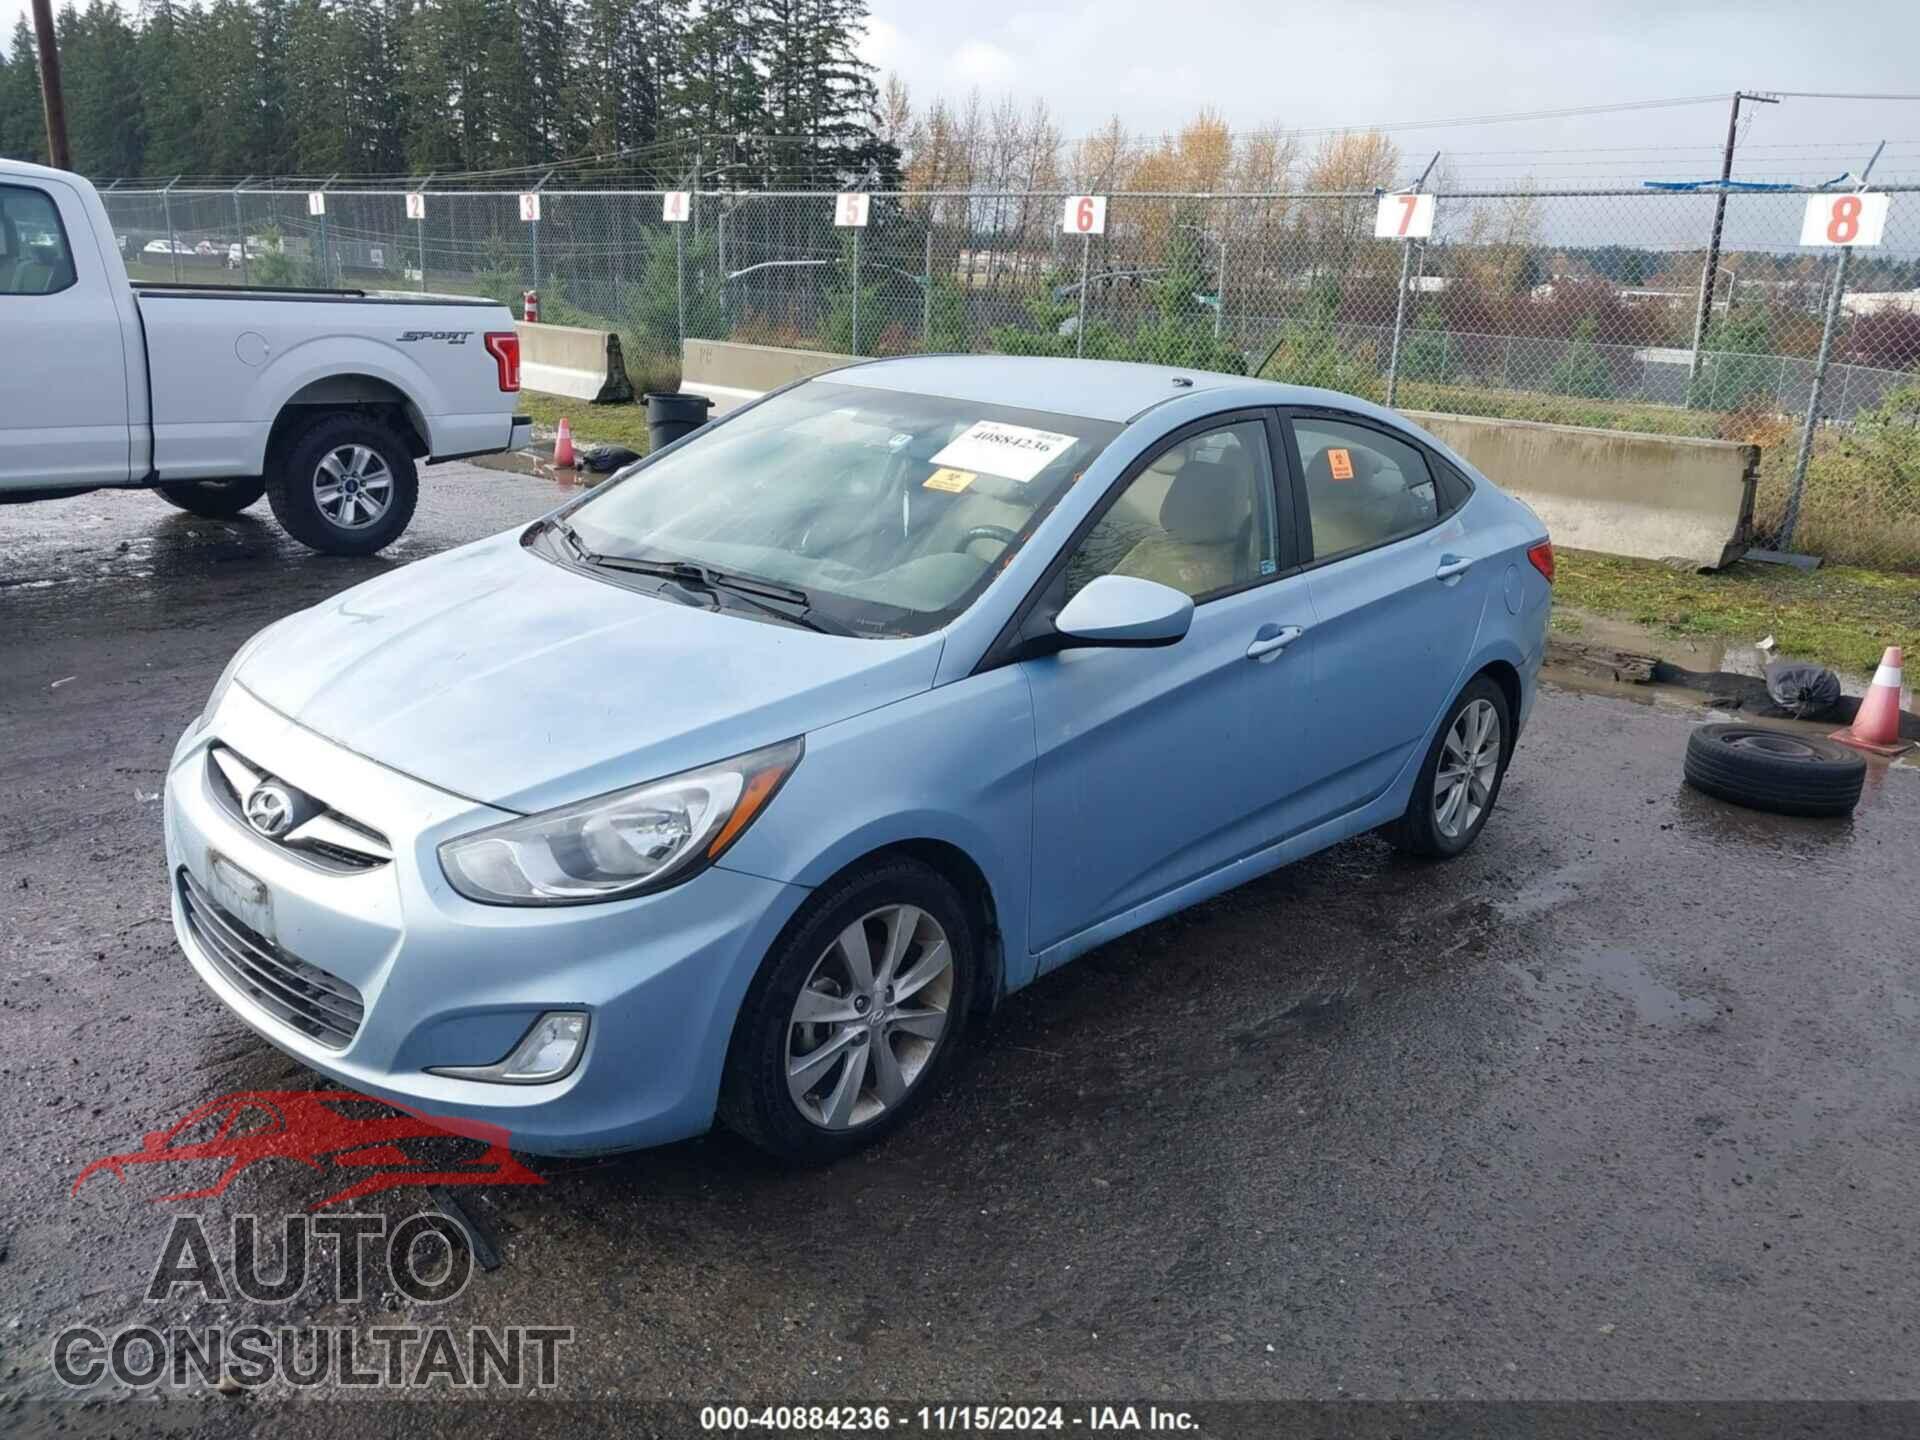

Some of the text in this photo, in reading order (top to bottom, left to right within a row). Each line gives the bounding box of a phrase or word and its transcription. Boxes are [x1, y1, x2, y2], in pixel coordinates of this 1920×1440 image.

[411, 195, 420, 217] 2
[525, 195, 535, 219] 3
[671, 192, 682, 219] 4
[846, 195, 858, 225] 5
[1076, 196, 1094, 232] 6
[1397, 196, 1418, 235] 7
[1826, 195, 1864, 244] 8
[396, 331, 475, 342] SPORT
[972, 431, 1050, 452] 40884236
